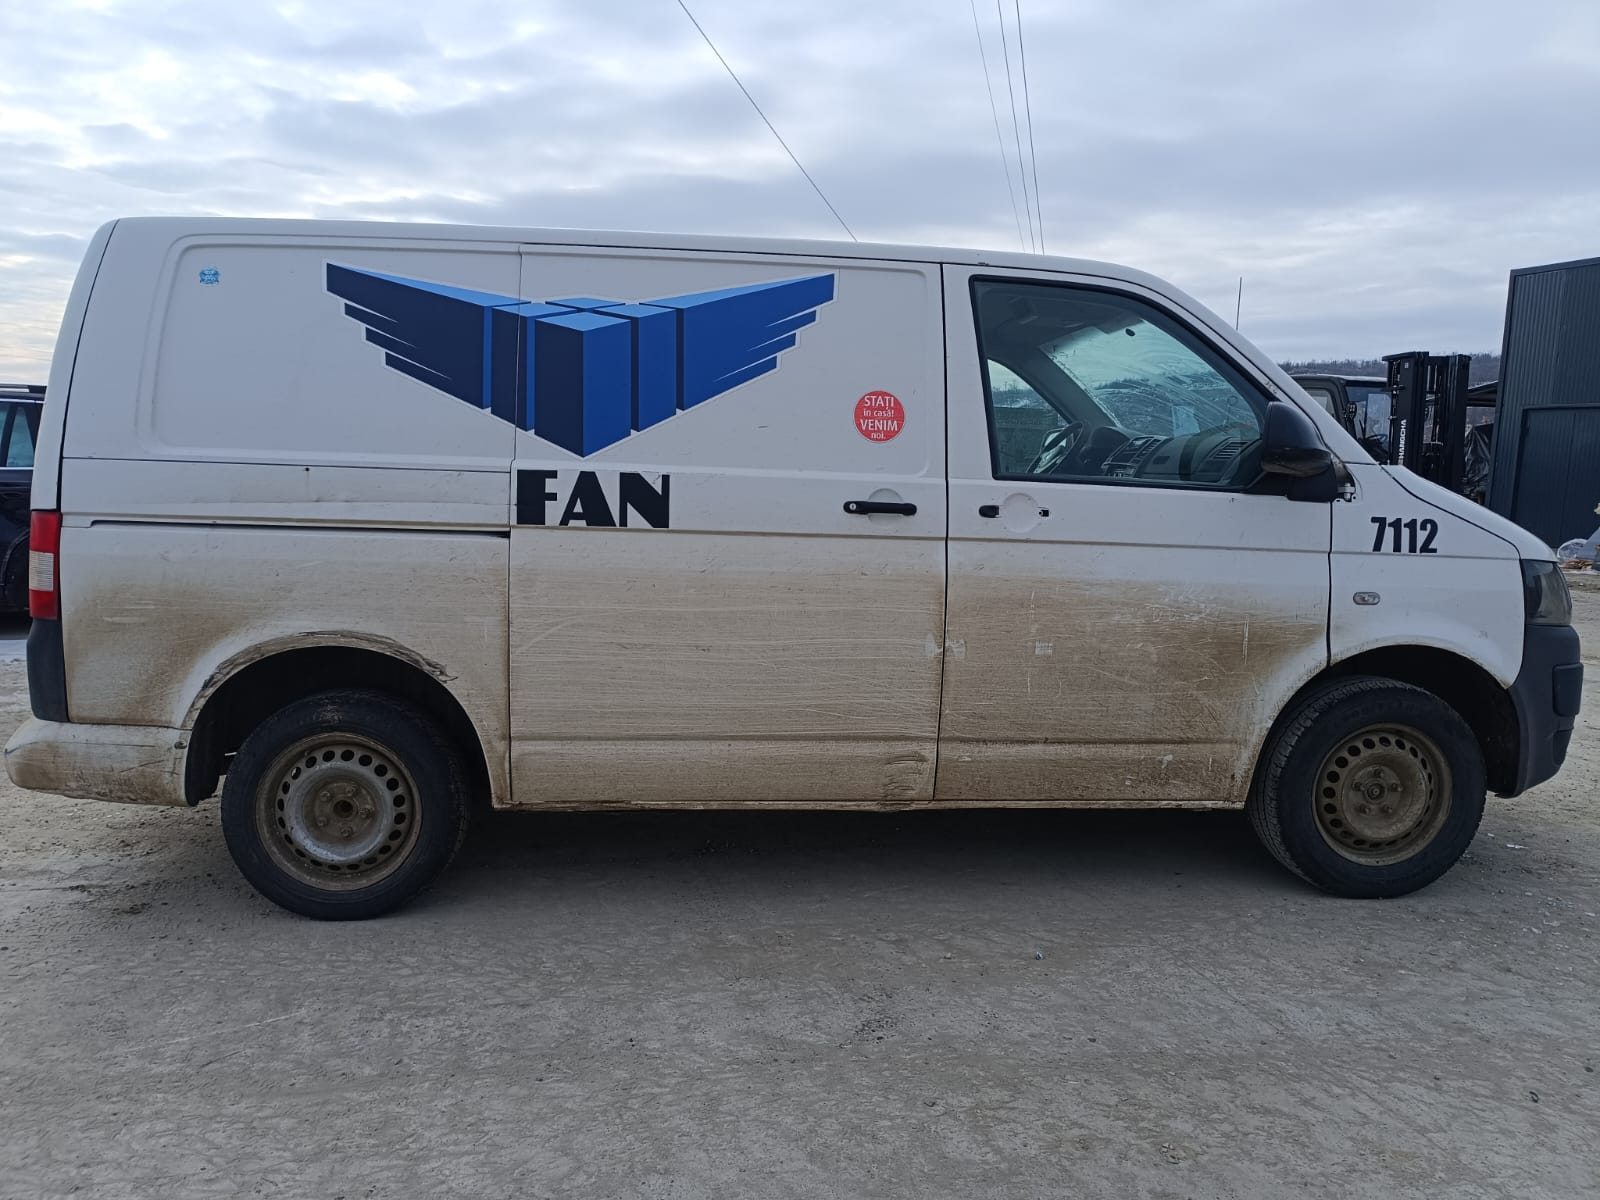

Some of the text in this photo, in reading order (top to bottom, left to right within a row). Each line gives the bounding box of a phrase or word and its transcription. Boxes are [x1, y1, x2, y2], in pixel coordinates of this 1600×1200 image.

[860, 419, 898, 431] VENIM
[516, 469, 670, 528] FAN
[1370, 516, 1439, 554] 7112
